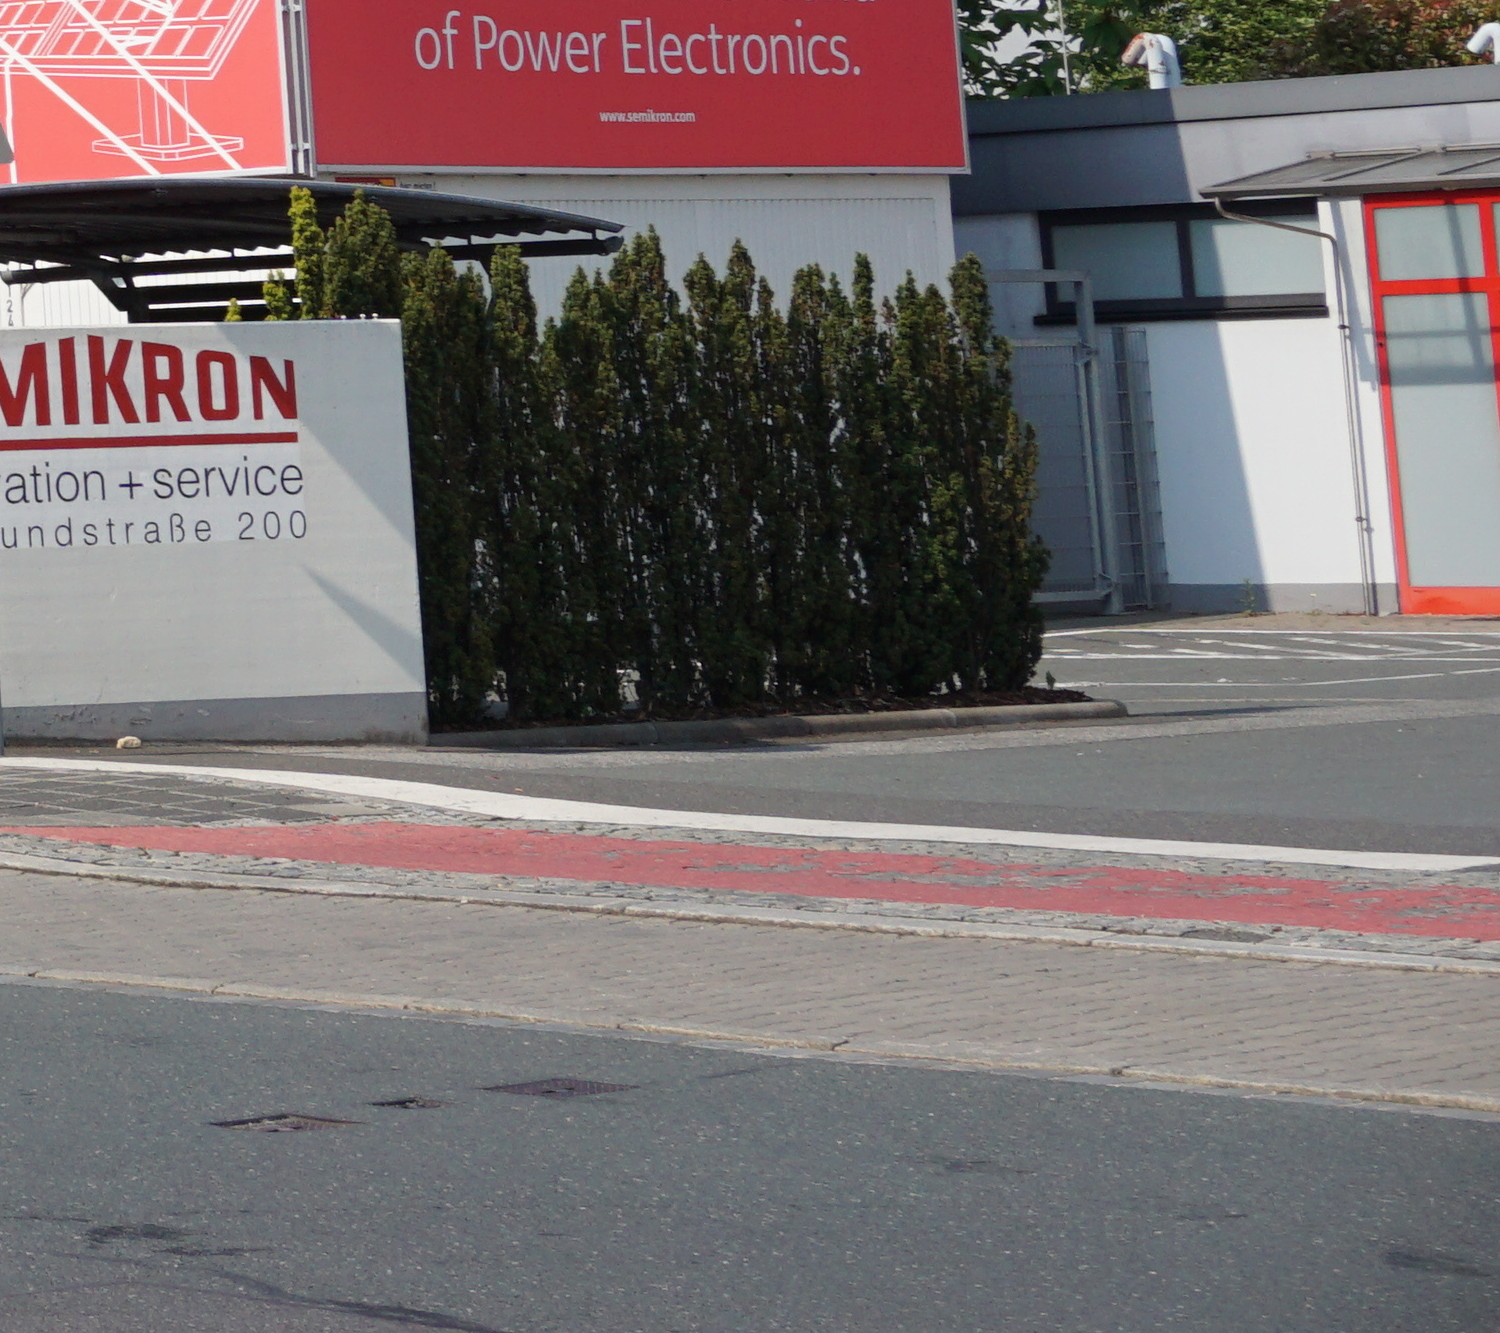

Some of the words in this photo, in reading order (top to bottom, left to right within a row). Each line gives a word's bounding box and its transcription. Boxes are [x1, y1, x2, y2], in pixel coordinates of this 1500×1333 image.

[414, 9, 461, 71] of
[472, 14, 607, 75] Power
[620, 15, 862, 76] Electronics.
[599, 108, 696, 123] www.semikron.com
[153, 455, 304, 500] service
[237, 510, 307, 541] 200
